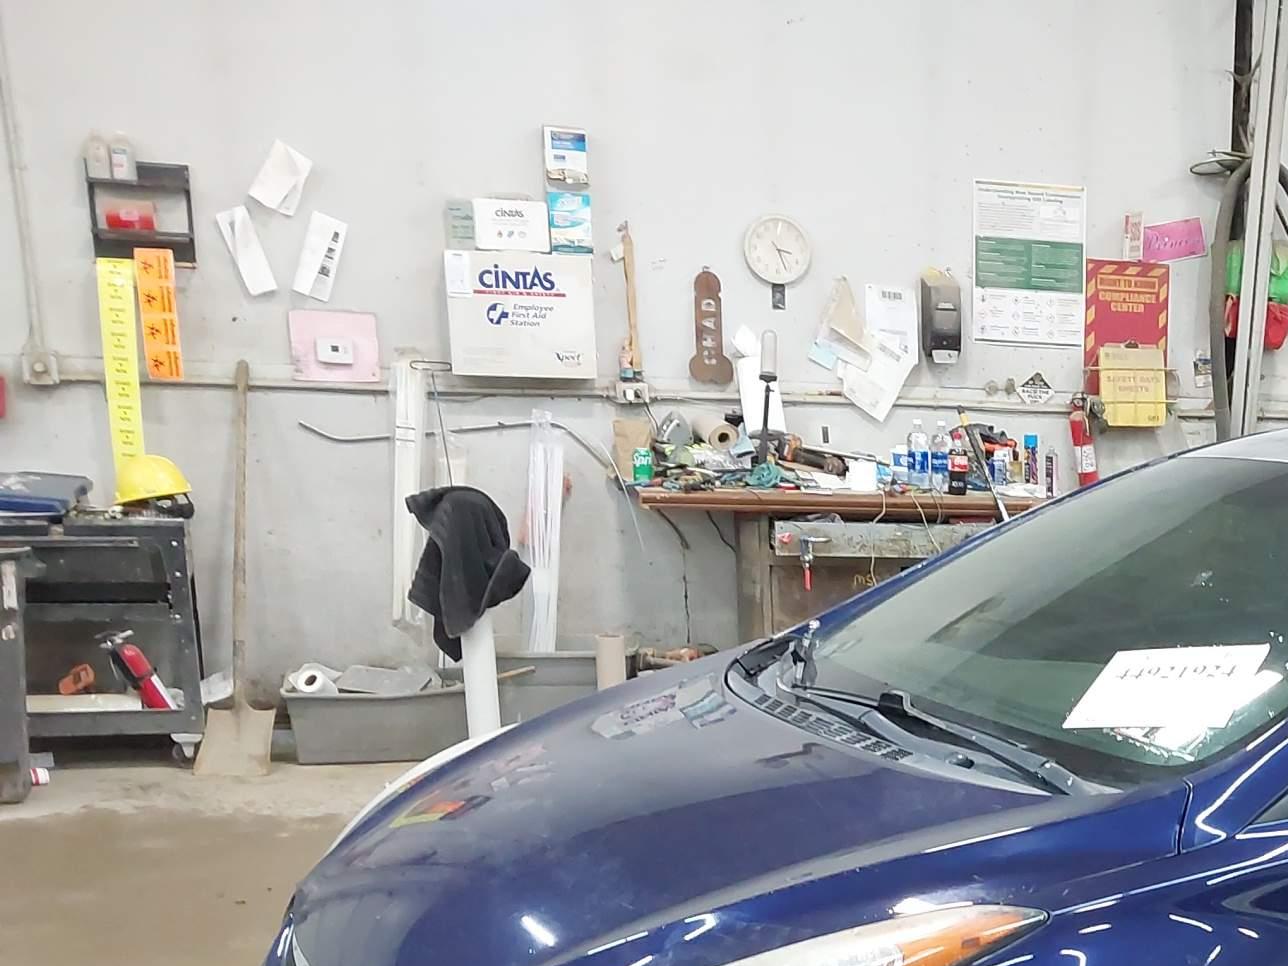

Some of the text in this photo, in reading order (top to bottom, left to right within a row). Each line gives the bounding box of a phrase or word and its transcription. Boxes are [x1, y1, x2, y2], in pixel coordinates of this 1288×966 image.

[478, 263, 556, 291] CINTAS
[1099, 290, 1157, 303] COMPLIANCE
[513, 303, 554, 314] Employee
[1110, 302, 1145, 313] CENTER
[510, 319, 540, 327] Station
